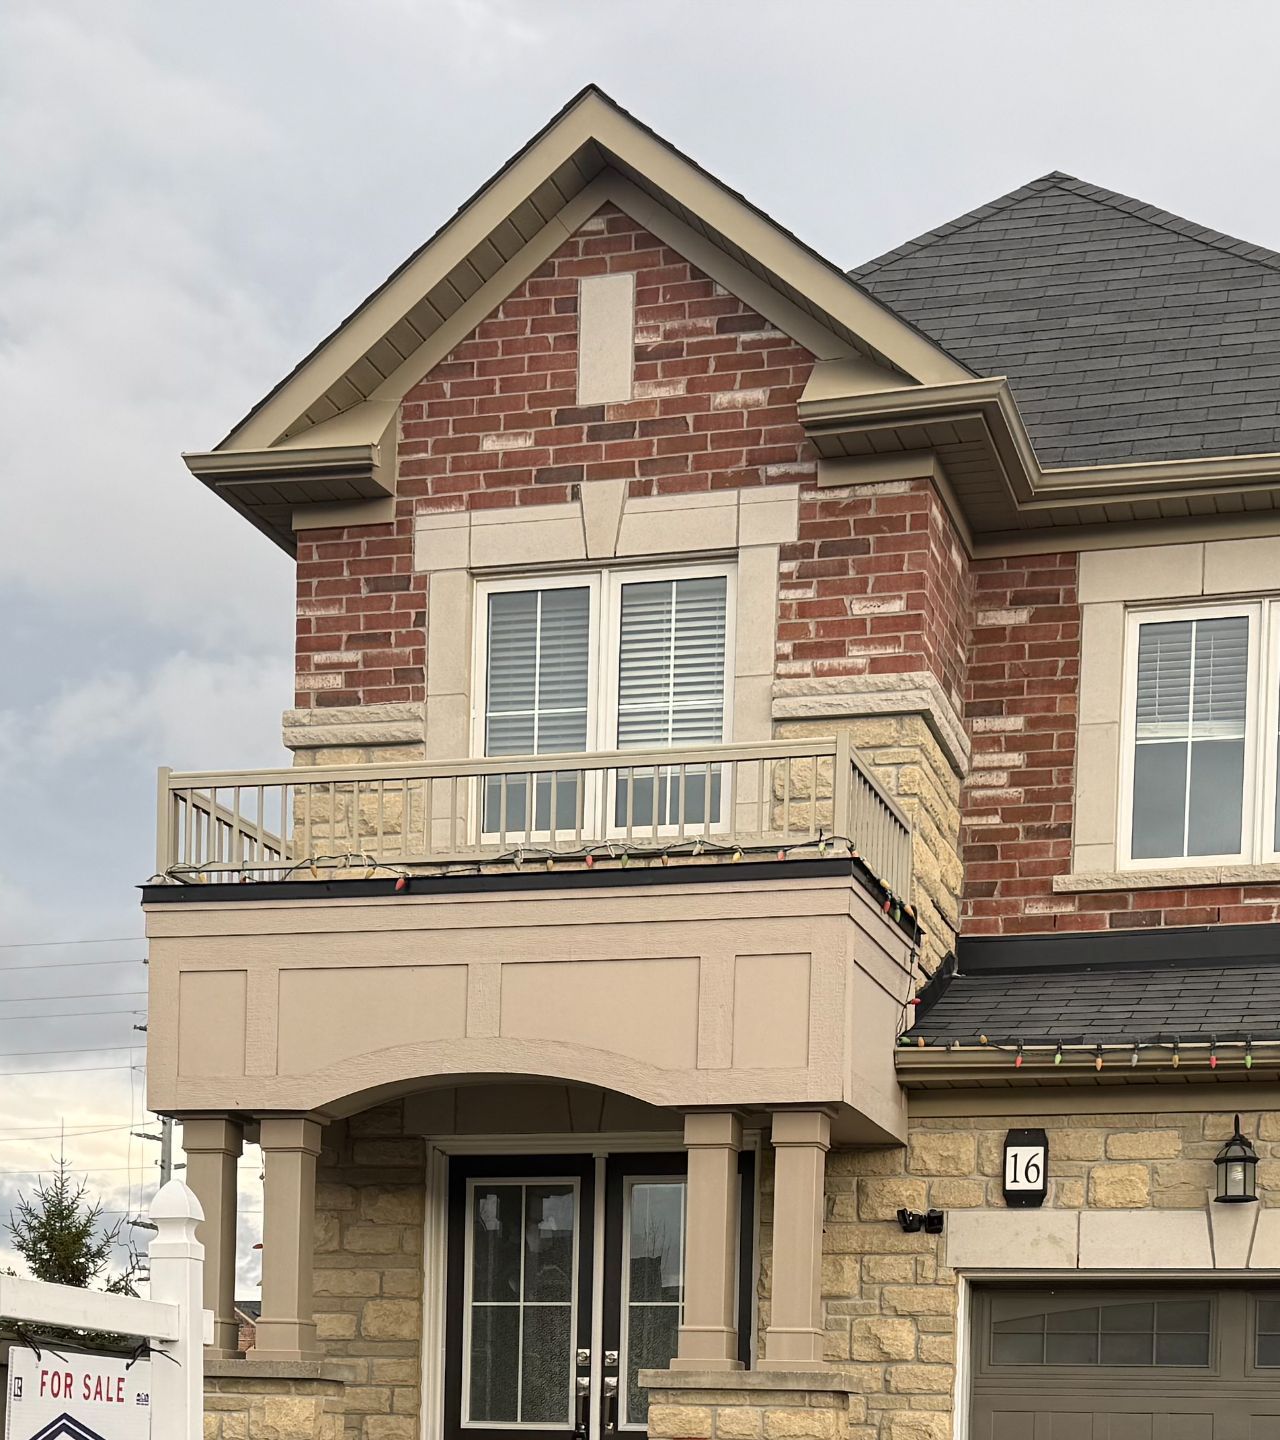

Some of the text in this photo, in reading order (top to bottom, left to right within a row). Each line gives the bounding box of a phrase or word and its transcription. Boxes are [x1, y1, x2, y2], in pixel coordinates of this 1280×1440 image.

[1010, 1152, 1040, 1183] 16
[40, 1370, 73, 1399] FOR
[83, 1373, 125, 1402] SALE
